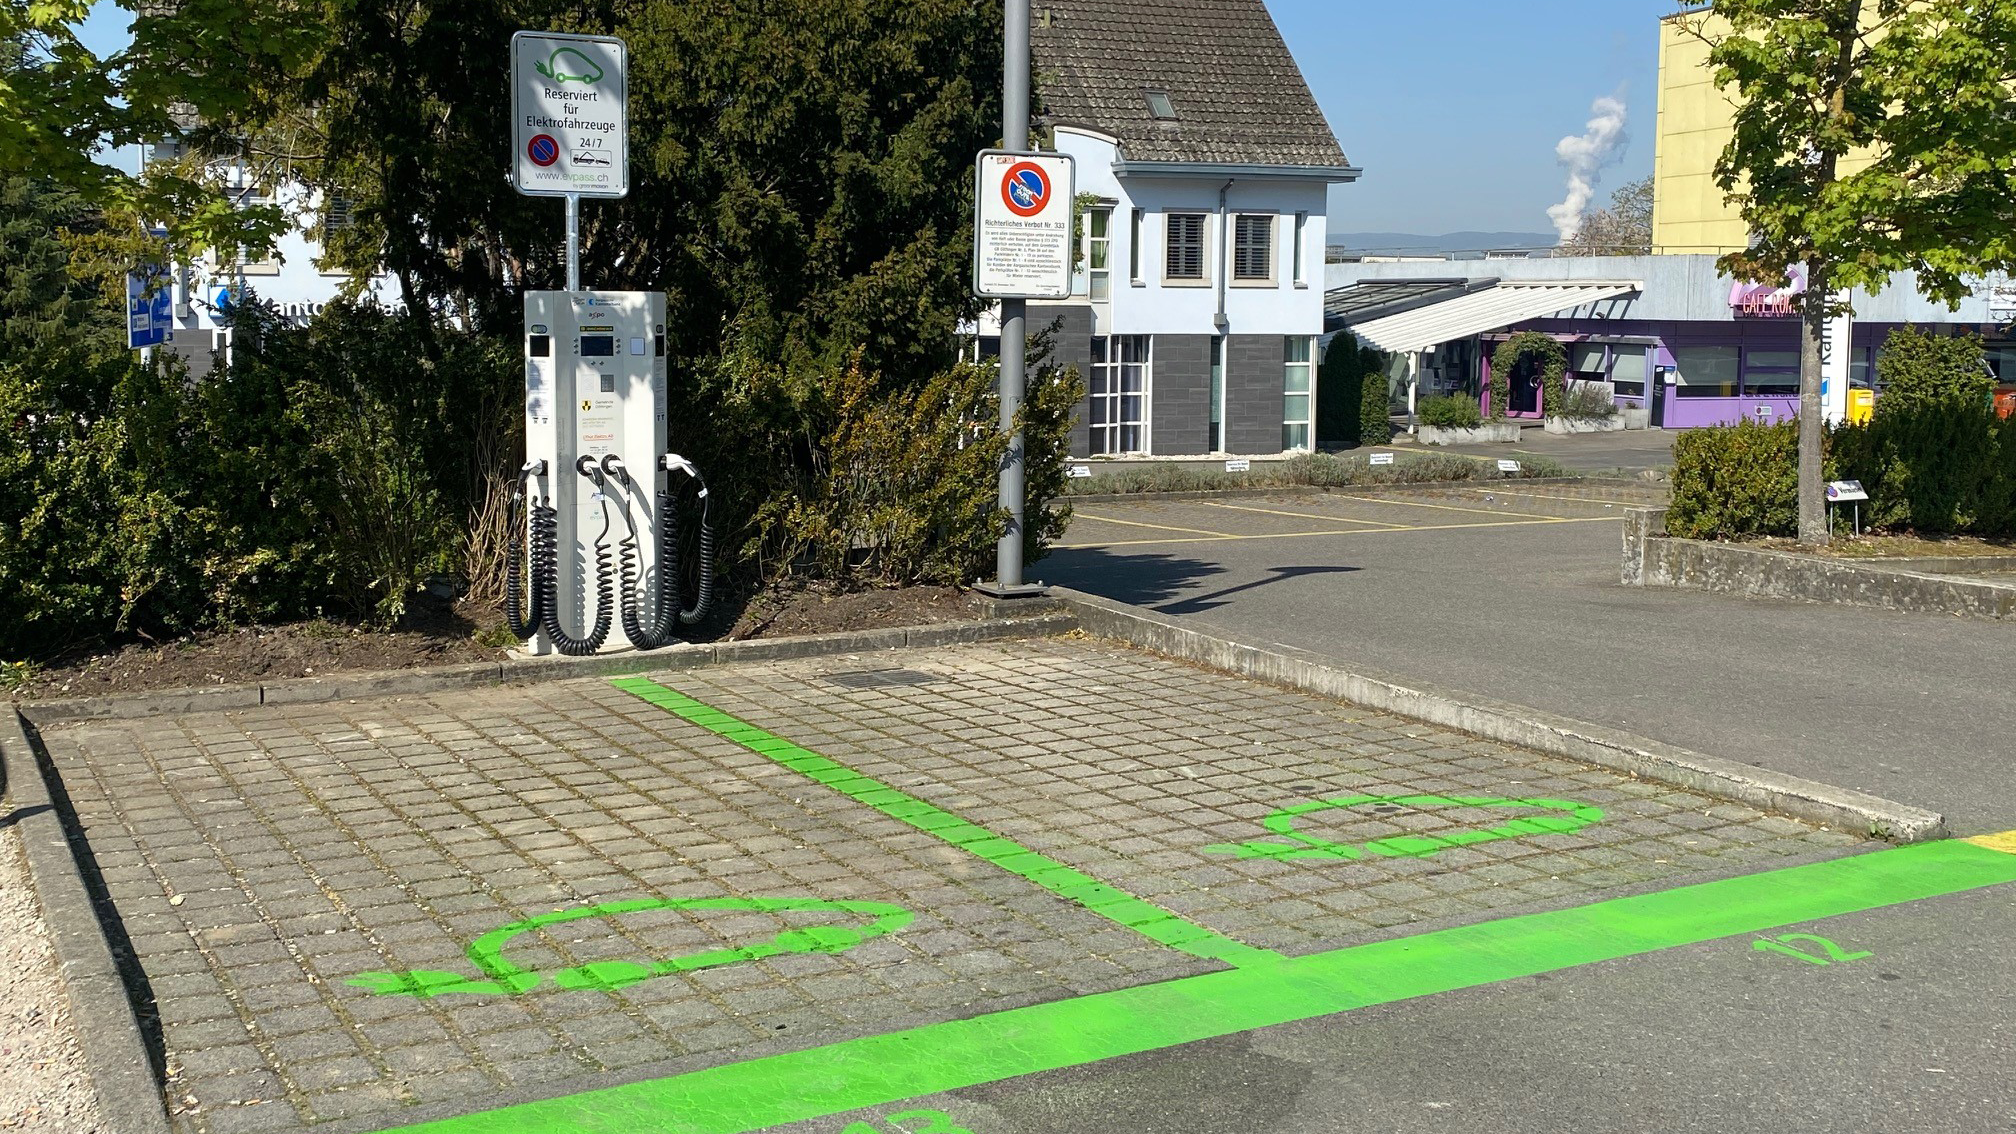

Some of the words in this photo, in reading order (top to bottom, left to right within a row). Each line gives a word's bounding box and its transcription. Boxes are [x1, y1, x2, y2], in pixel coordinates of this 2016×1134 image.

[545, 88, 597, 102] Reserviert
[564, 103, 578, 115] für
[527, 116, 616, 133] Elektrofahrzeuge
[535, 171, 608, 183] www.evpass.ch
[1753, 933, 1875, 966] 12
